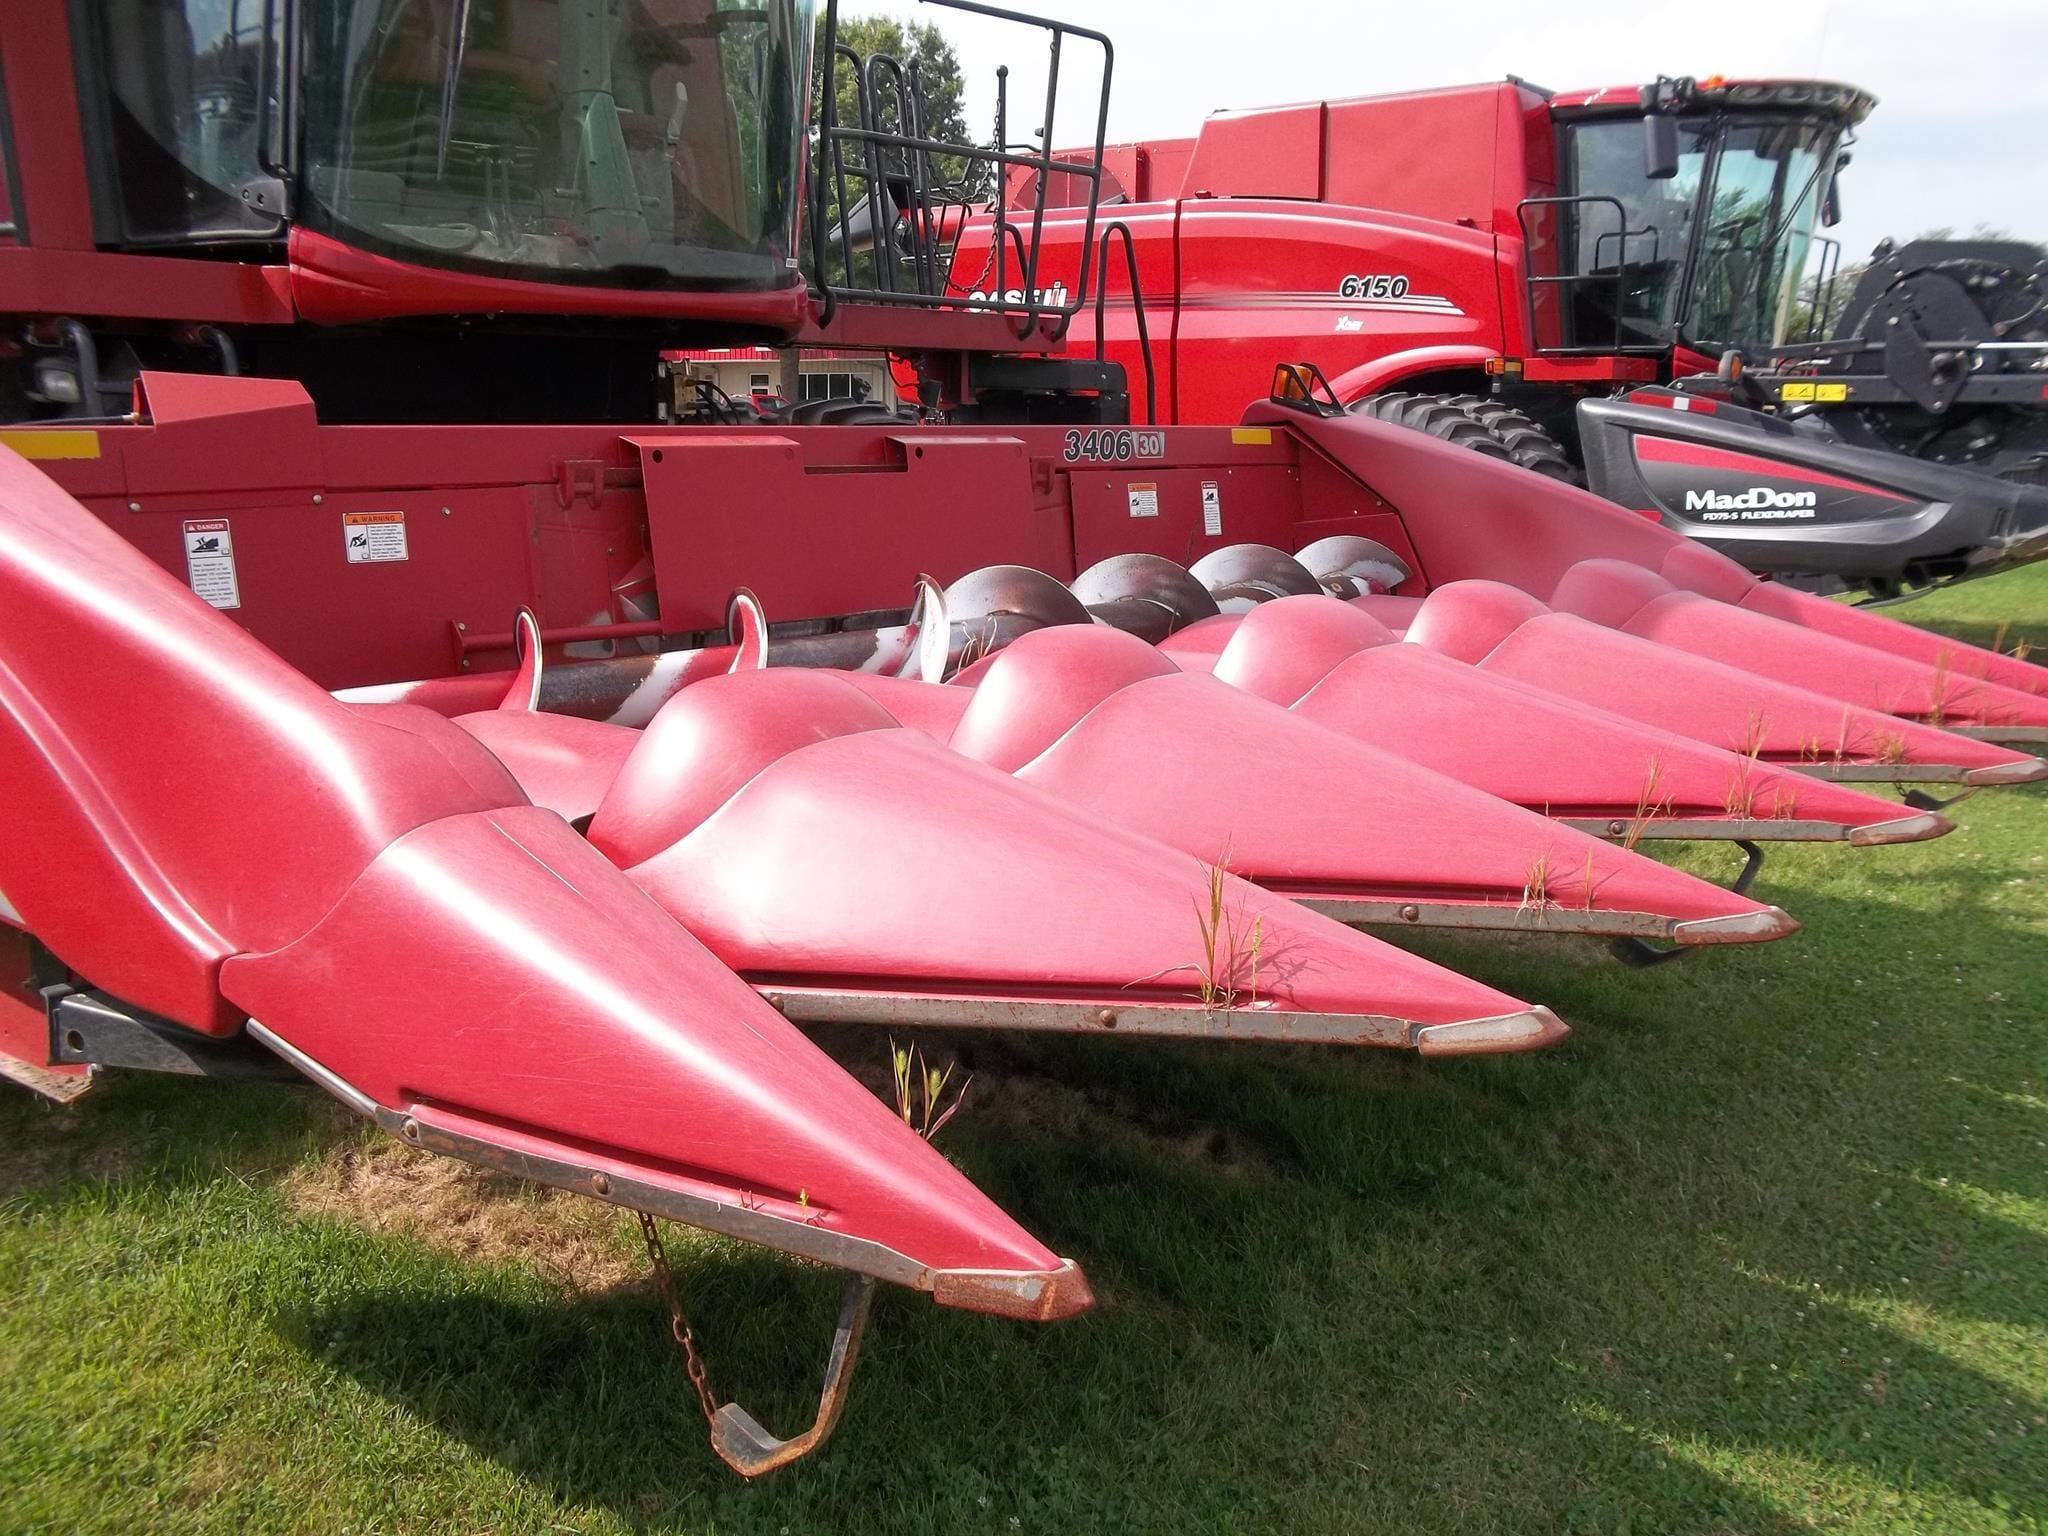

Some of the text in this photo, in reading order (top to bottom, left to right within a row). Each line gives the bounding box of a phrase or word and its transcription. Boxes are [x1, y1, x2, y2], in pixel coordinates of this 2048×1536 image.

[1340, 275, 1409, 299] 6150
[1064, 429, 1159, 461] 3406 30
[1685, 487, 1817, 511] MacDon
[196, 523, 225, 531] DANGER
